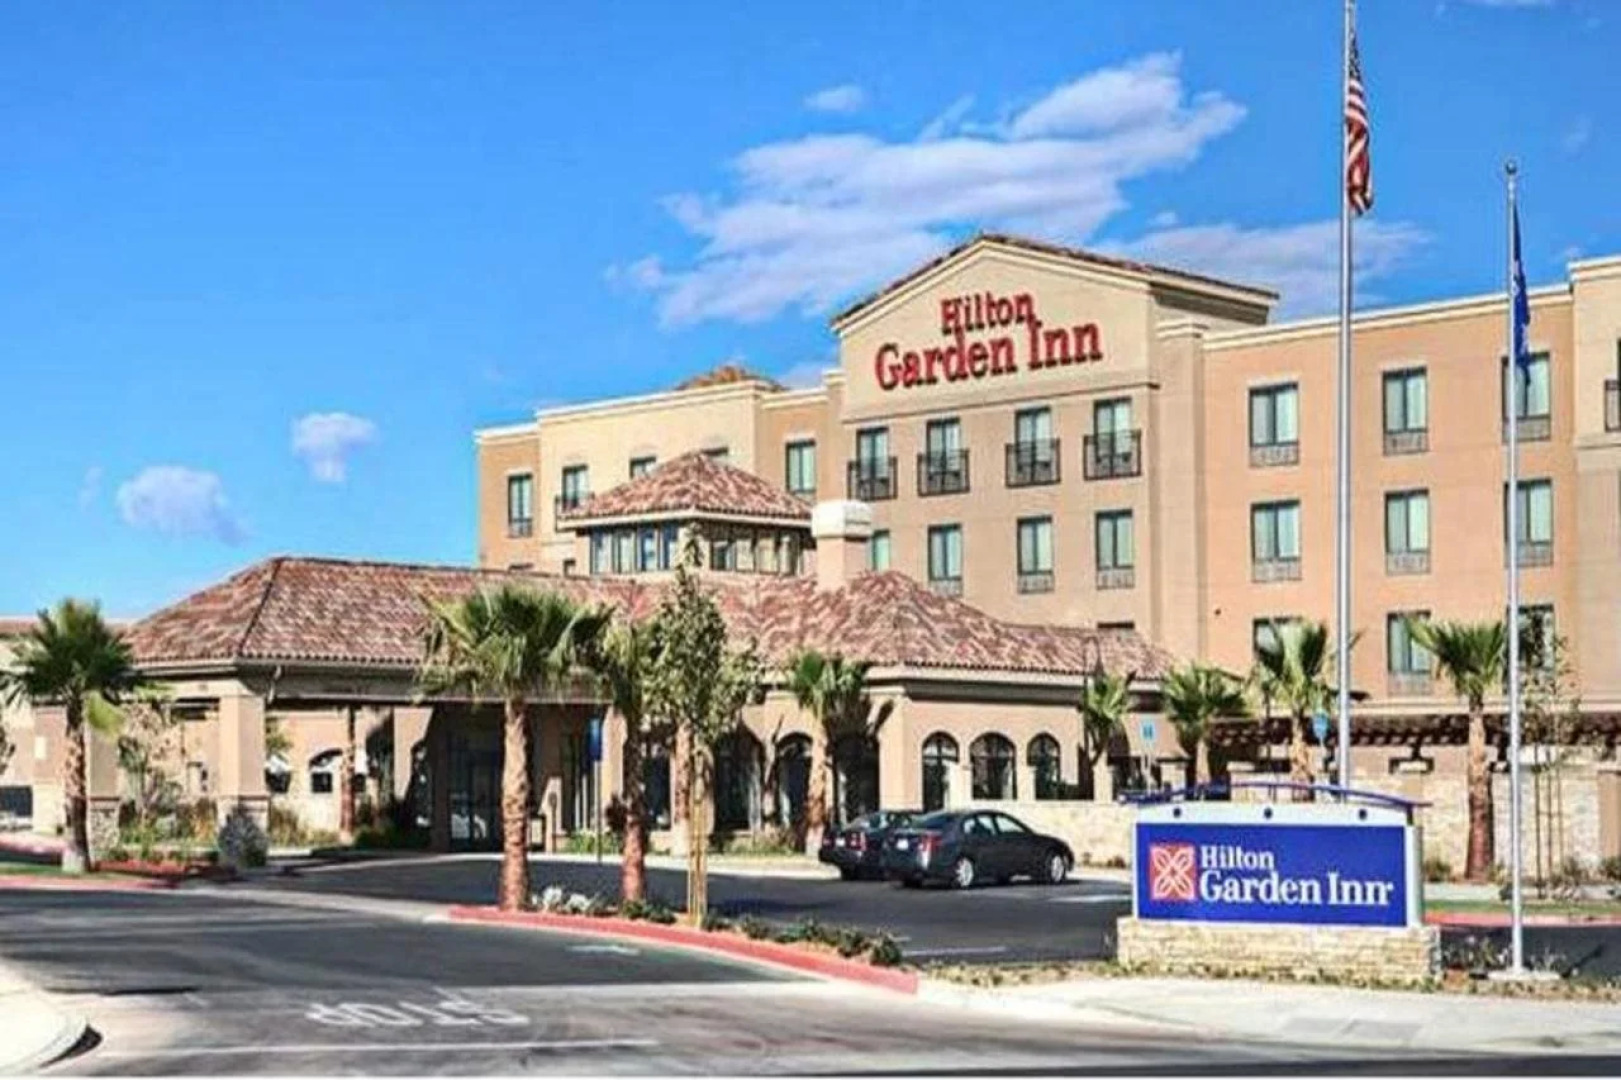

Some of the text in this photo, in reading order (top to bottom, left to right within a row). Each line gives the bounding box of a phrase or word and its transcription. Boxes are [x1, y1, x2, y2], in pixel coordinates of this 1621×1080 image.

[941, 291, 1035, 335] Hilton
[875, 318, 1103, 391] Garden Inn
[1201, 845, 1275, 870] Hilton
[1200, 869, 1391, 906] Garden Inn
